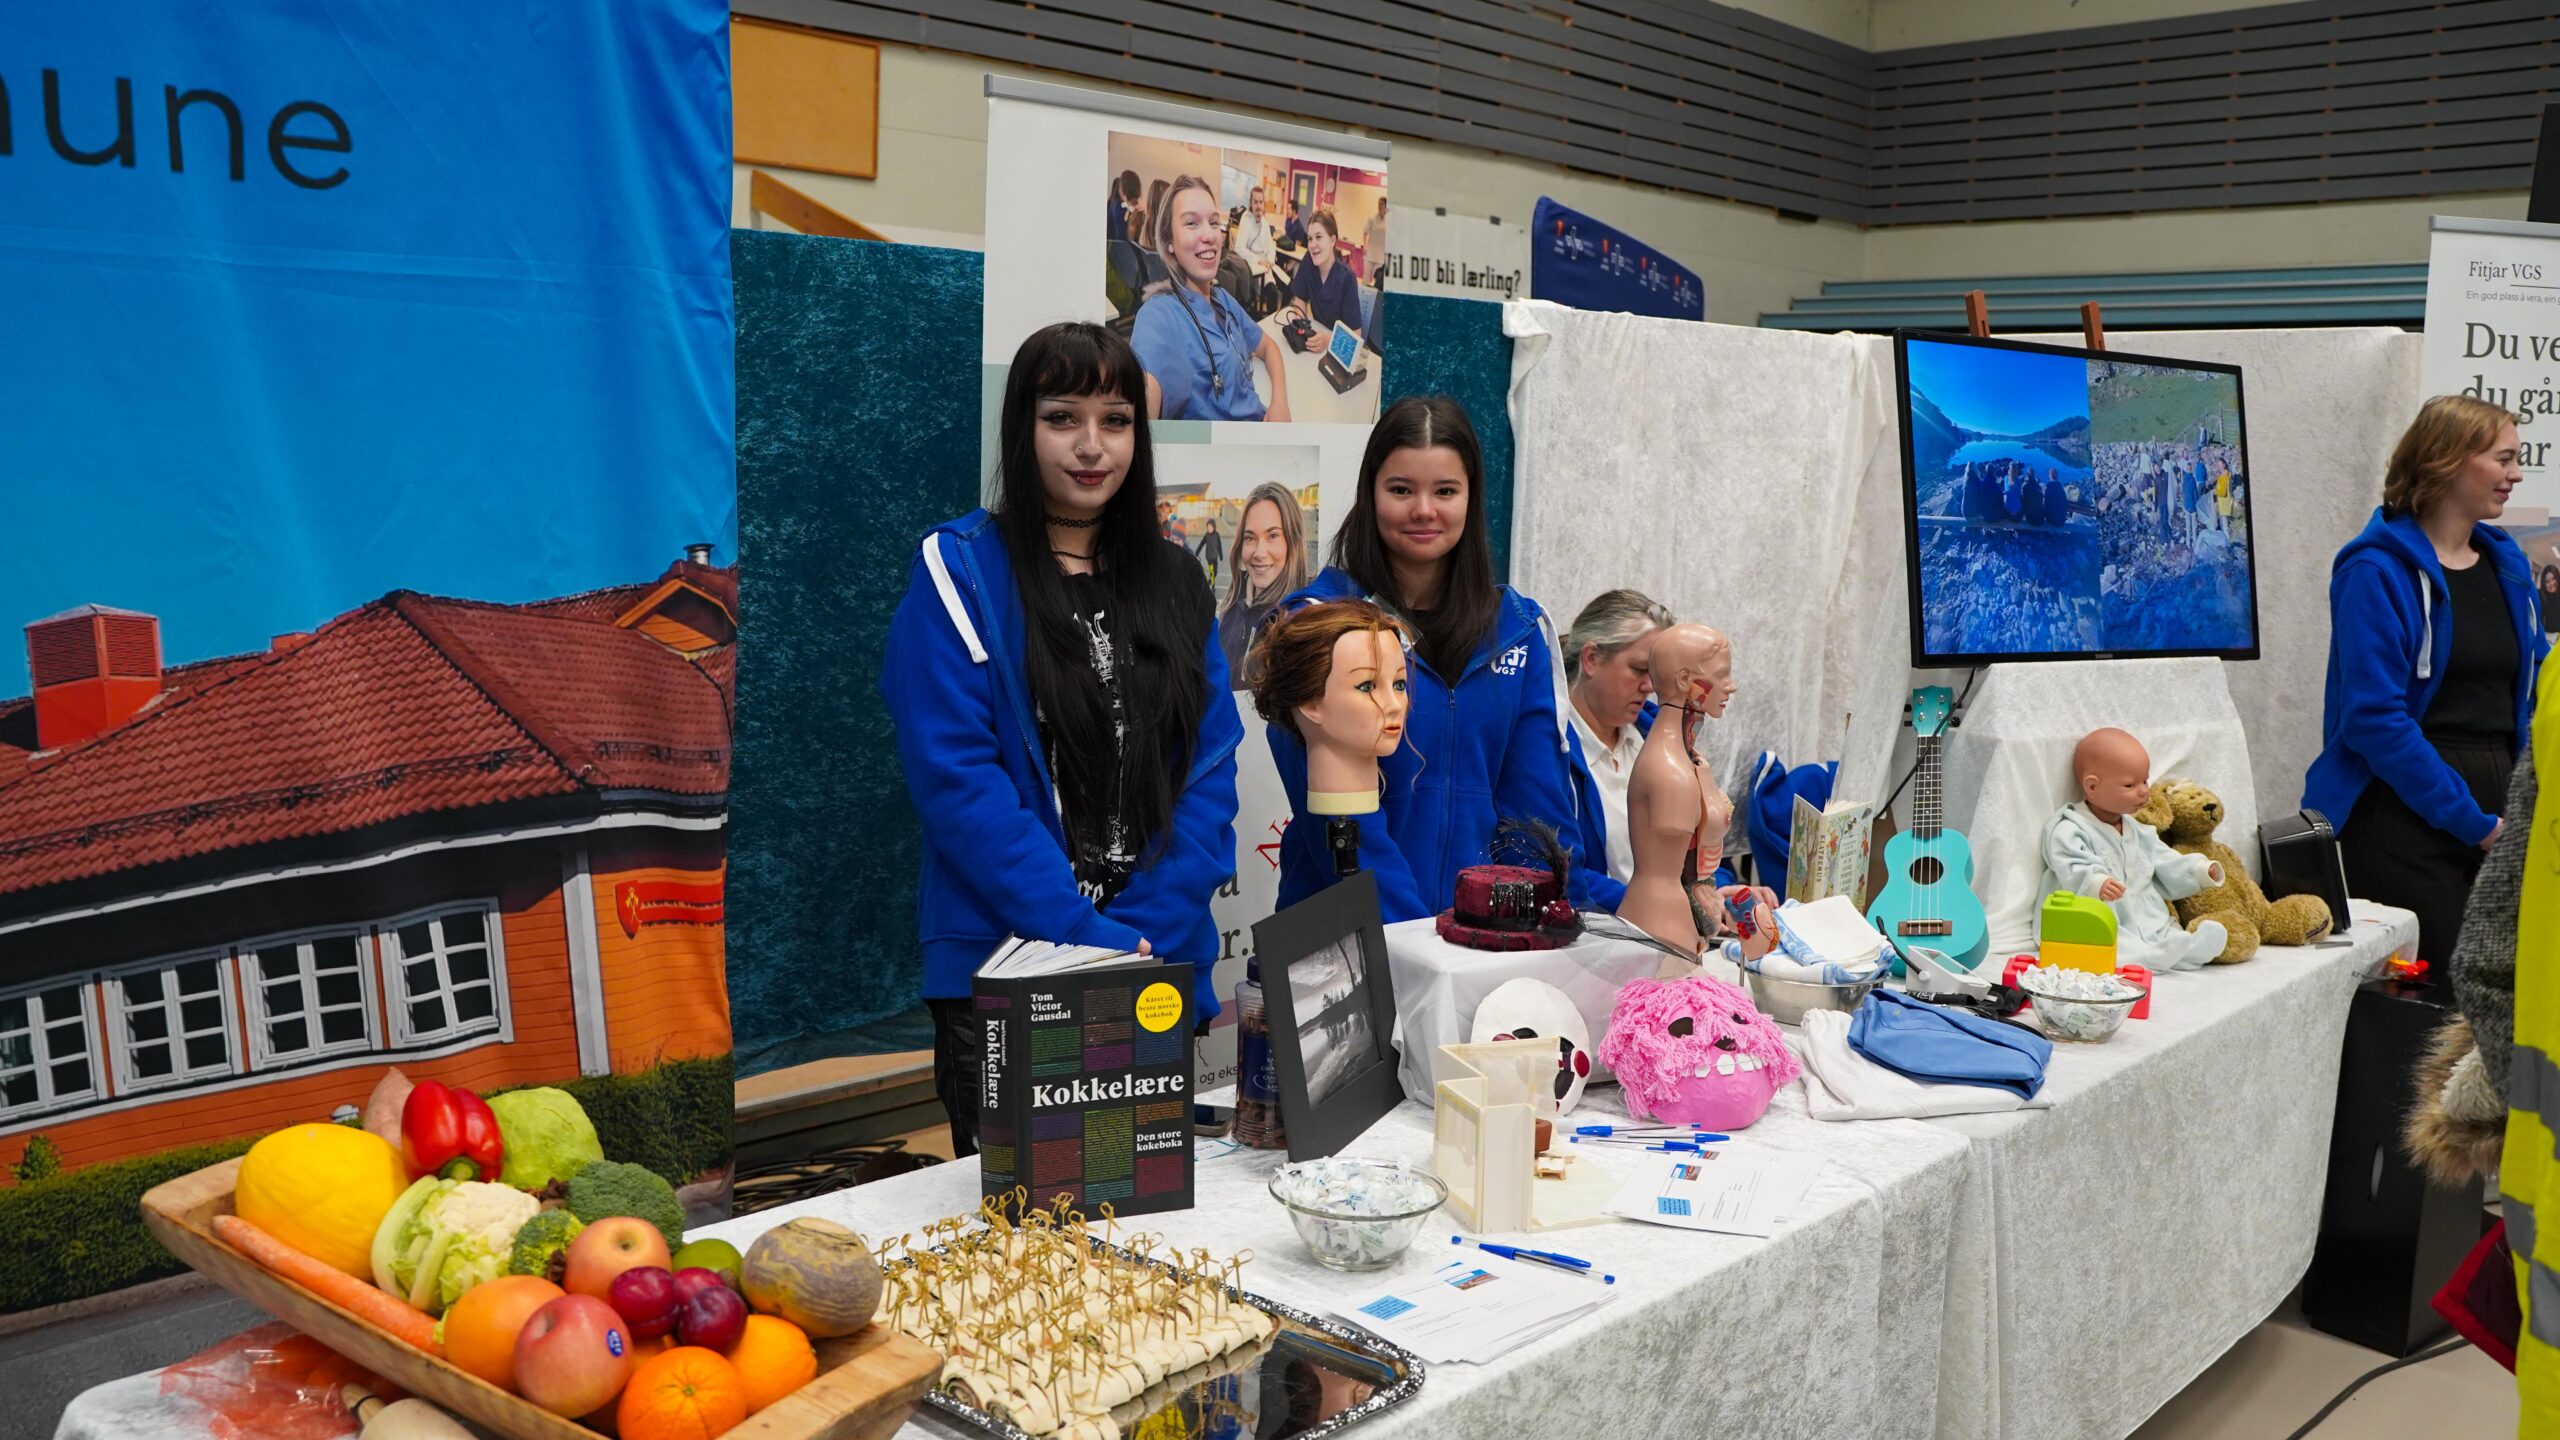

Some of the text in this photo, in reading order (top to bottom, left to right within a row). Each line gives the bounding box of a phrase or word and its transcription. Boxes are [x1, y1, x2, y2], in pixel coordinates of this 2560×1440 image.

[1410, 255, 1430, 282] DU
[1436, 259, 1455, 286] bli
[1461, 262, 1521, 299] lærling?
[2468, 260, 2542, 282] Fitjar VGS
[2466, 290, 2479, 300] Ein
[2481, 291, 2498, 302] god
[2500, 292, 2519, 302] plass
[2544, 295, 2556, 303] ein
[2462, 322, 2520, 360] Du
[1816, 834, 1826, 883] KLATREMUS
[1031, 993, 1053, 1002] Tom
[1031, 1002, 1062, 1012] Victor
[1031, 1010, 1071, 1022] Gausdal
[986, 1019, 1001, 1109] Kokkelære
[1199, 1064, 1238, 1085] og eks
[1032, 1073, 1185, 1108] Kokkelære
[1136, 1130, 1181, 1143] Den store
[1136, 1138, 1183, 1152] kokeboka
